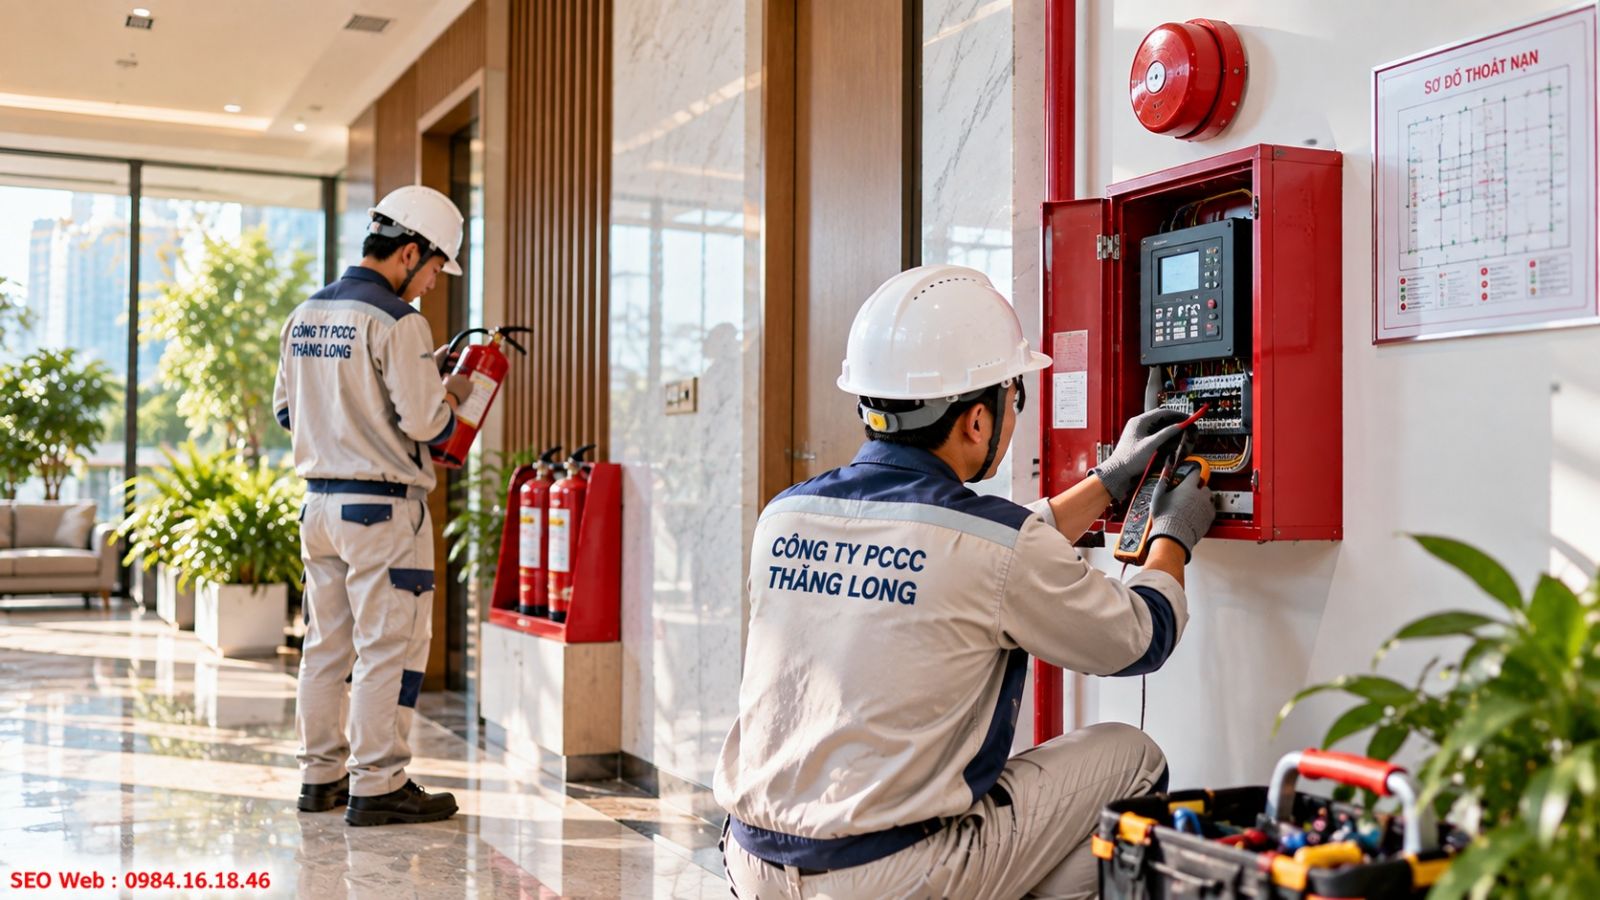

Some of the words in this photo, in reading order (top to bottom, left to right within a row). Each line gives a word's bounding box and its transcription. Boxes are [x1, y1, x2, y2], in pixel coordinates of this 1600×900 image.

[1510, 49, 1539, 72] NẠN
[319, 325, 330, 338] TY
[330, 326, 356, 340] PCCC
[324, 344, 351, 359] LONG
[771, 532, 829, 562] CÔNG
[834, 541, 862, 565] TY
[863, 544, 927, 573] PCCC
[768, 564, 843, 596] THĂNG
[847, 575, 918, 606] LONG
